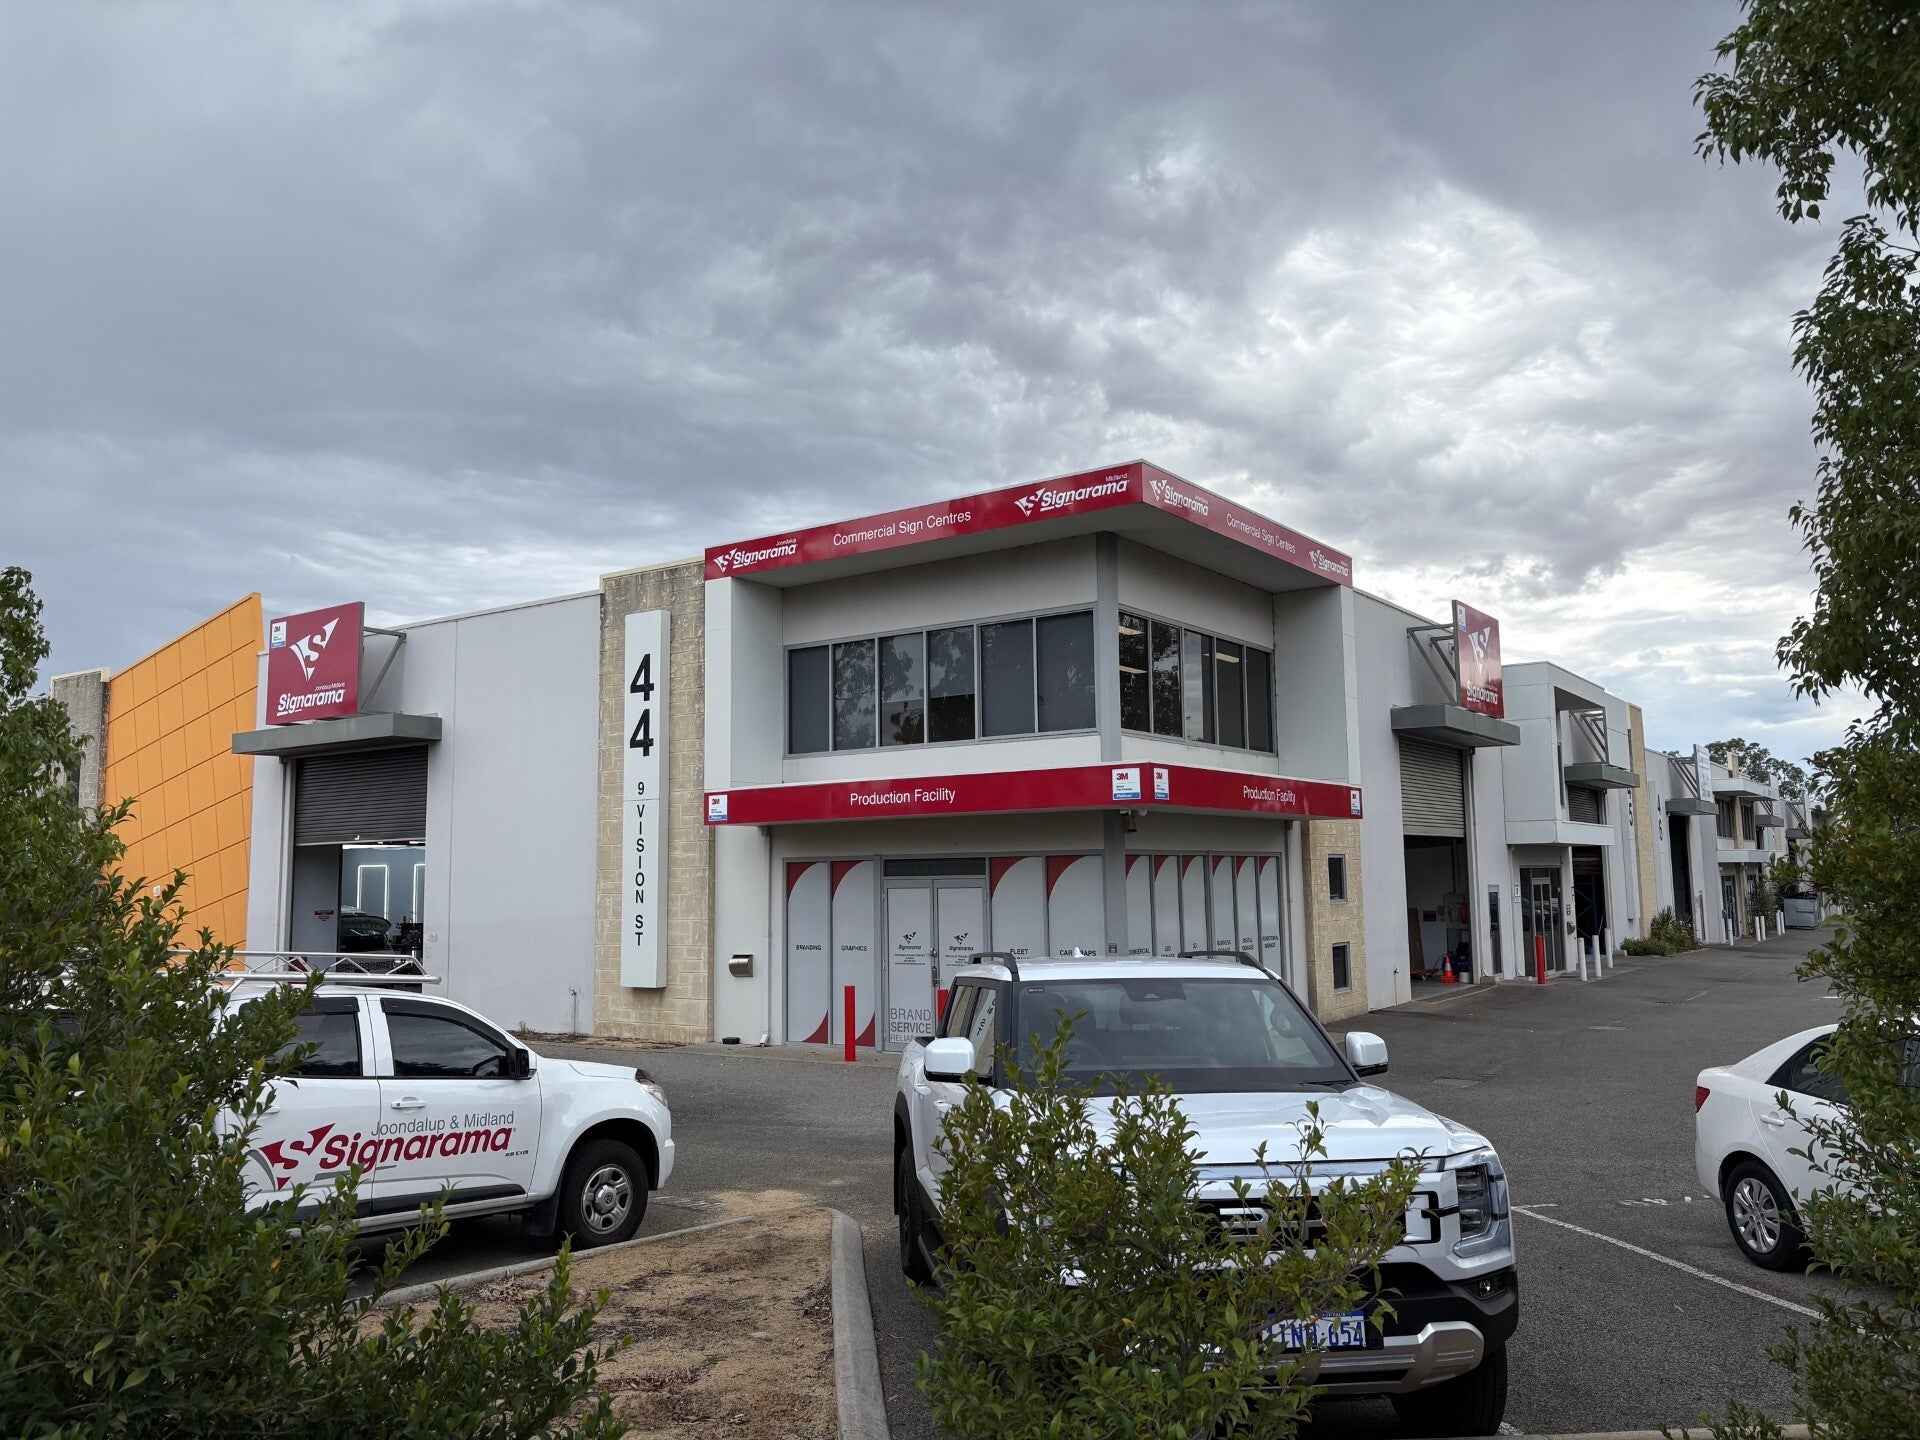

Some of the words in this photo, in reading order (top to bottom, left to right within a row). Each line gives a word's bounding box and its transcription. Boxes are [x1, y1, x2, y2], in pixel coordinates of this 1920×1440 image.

[1105, 472, 1128, 482] Midland
[1041, 479, 1128, 508] Signarama
[1164, 485, 1209, 516] Signarama
[833, 523, 896, 546] Commercial
[899, 520, 923, 535] Sign
[926, 511, 971, 529] Centres
[1226, 513, 1261, 539] Commercial
[1261, 529, 1275, 546] Sign
[1275, 535, 1296, 554] Centres
[732, 544, 797, 566] Signarama
[1318, 554, 1349, 577] Signarama
[277, 689, 345, 713] Signarama
[1466, 680, 1498, 705] Signarama
[629, 654, 655, 757] 44
[637, 781, 645, 796] 9
[850, 790, 911, 806] Production
[914, 787, 956, 803] Facility
[1243, 785, 1275, 801] Production
[1276, 788, 1296, 805] Facility
[635, 804, 645, 904] VISION
[634, 914, 643, 946] ST
[890, 1008, 931, 1021] BRAND
[890, 1021, 932, 1034] SERVICE
[371, 1117, 446, 1137] Joondalup
[449, 1115, 460, 1130] &
[464, 1110, 515, 1128] Midland
[319, 1127, 513, 1174] Signarama
